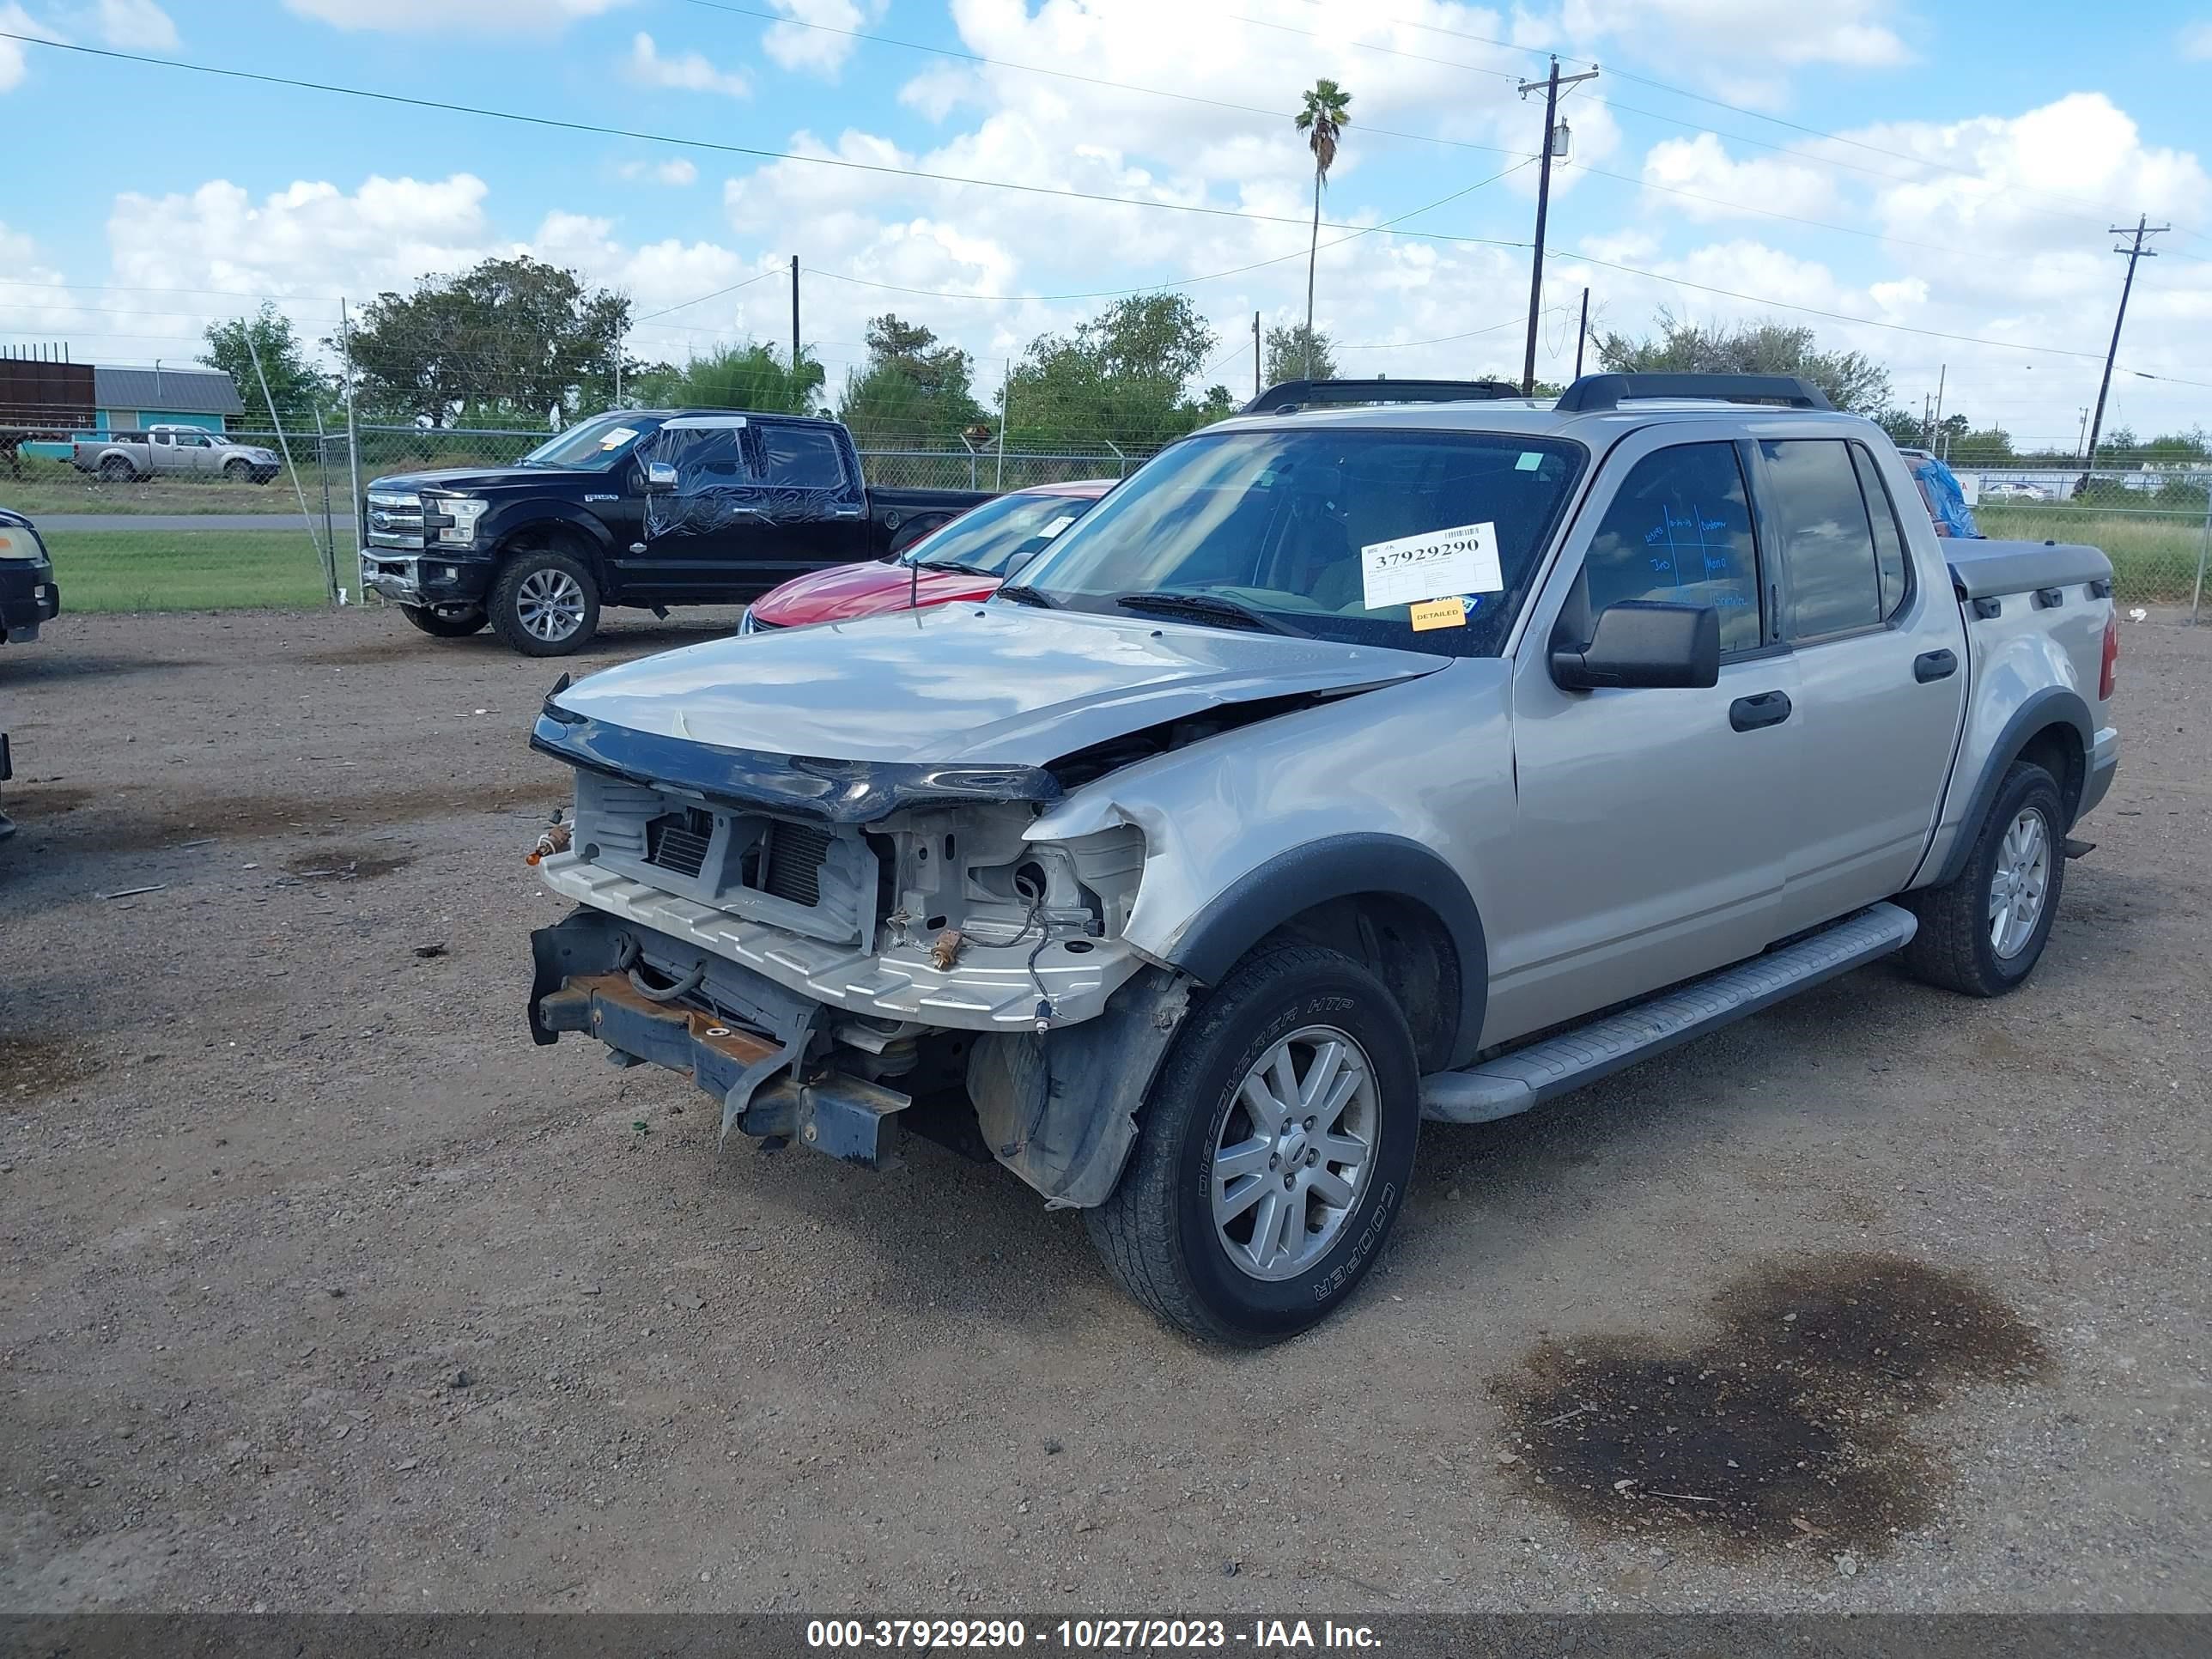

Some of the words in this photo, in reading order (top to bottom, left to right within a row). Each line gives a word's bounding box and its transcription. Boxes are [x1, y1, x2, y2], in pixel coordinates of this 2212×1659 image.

[1375, 538, 1480, 569] 37929290
[1417, 609, 1459, 621] DETAILED
[1198, 1006, 1298, 1197] DISCOVERER
[1307, 996, 1354, 1013] HTP
[1313, 1182, 1396, 1302] COOPER
